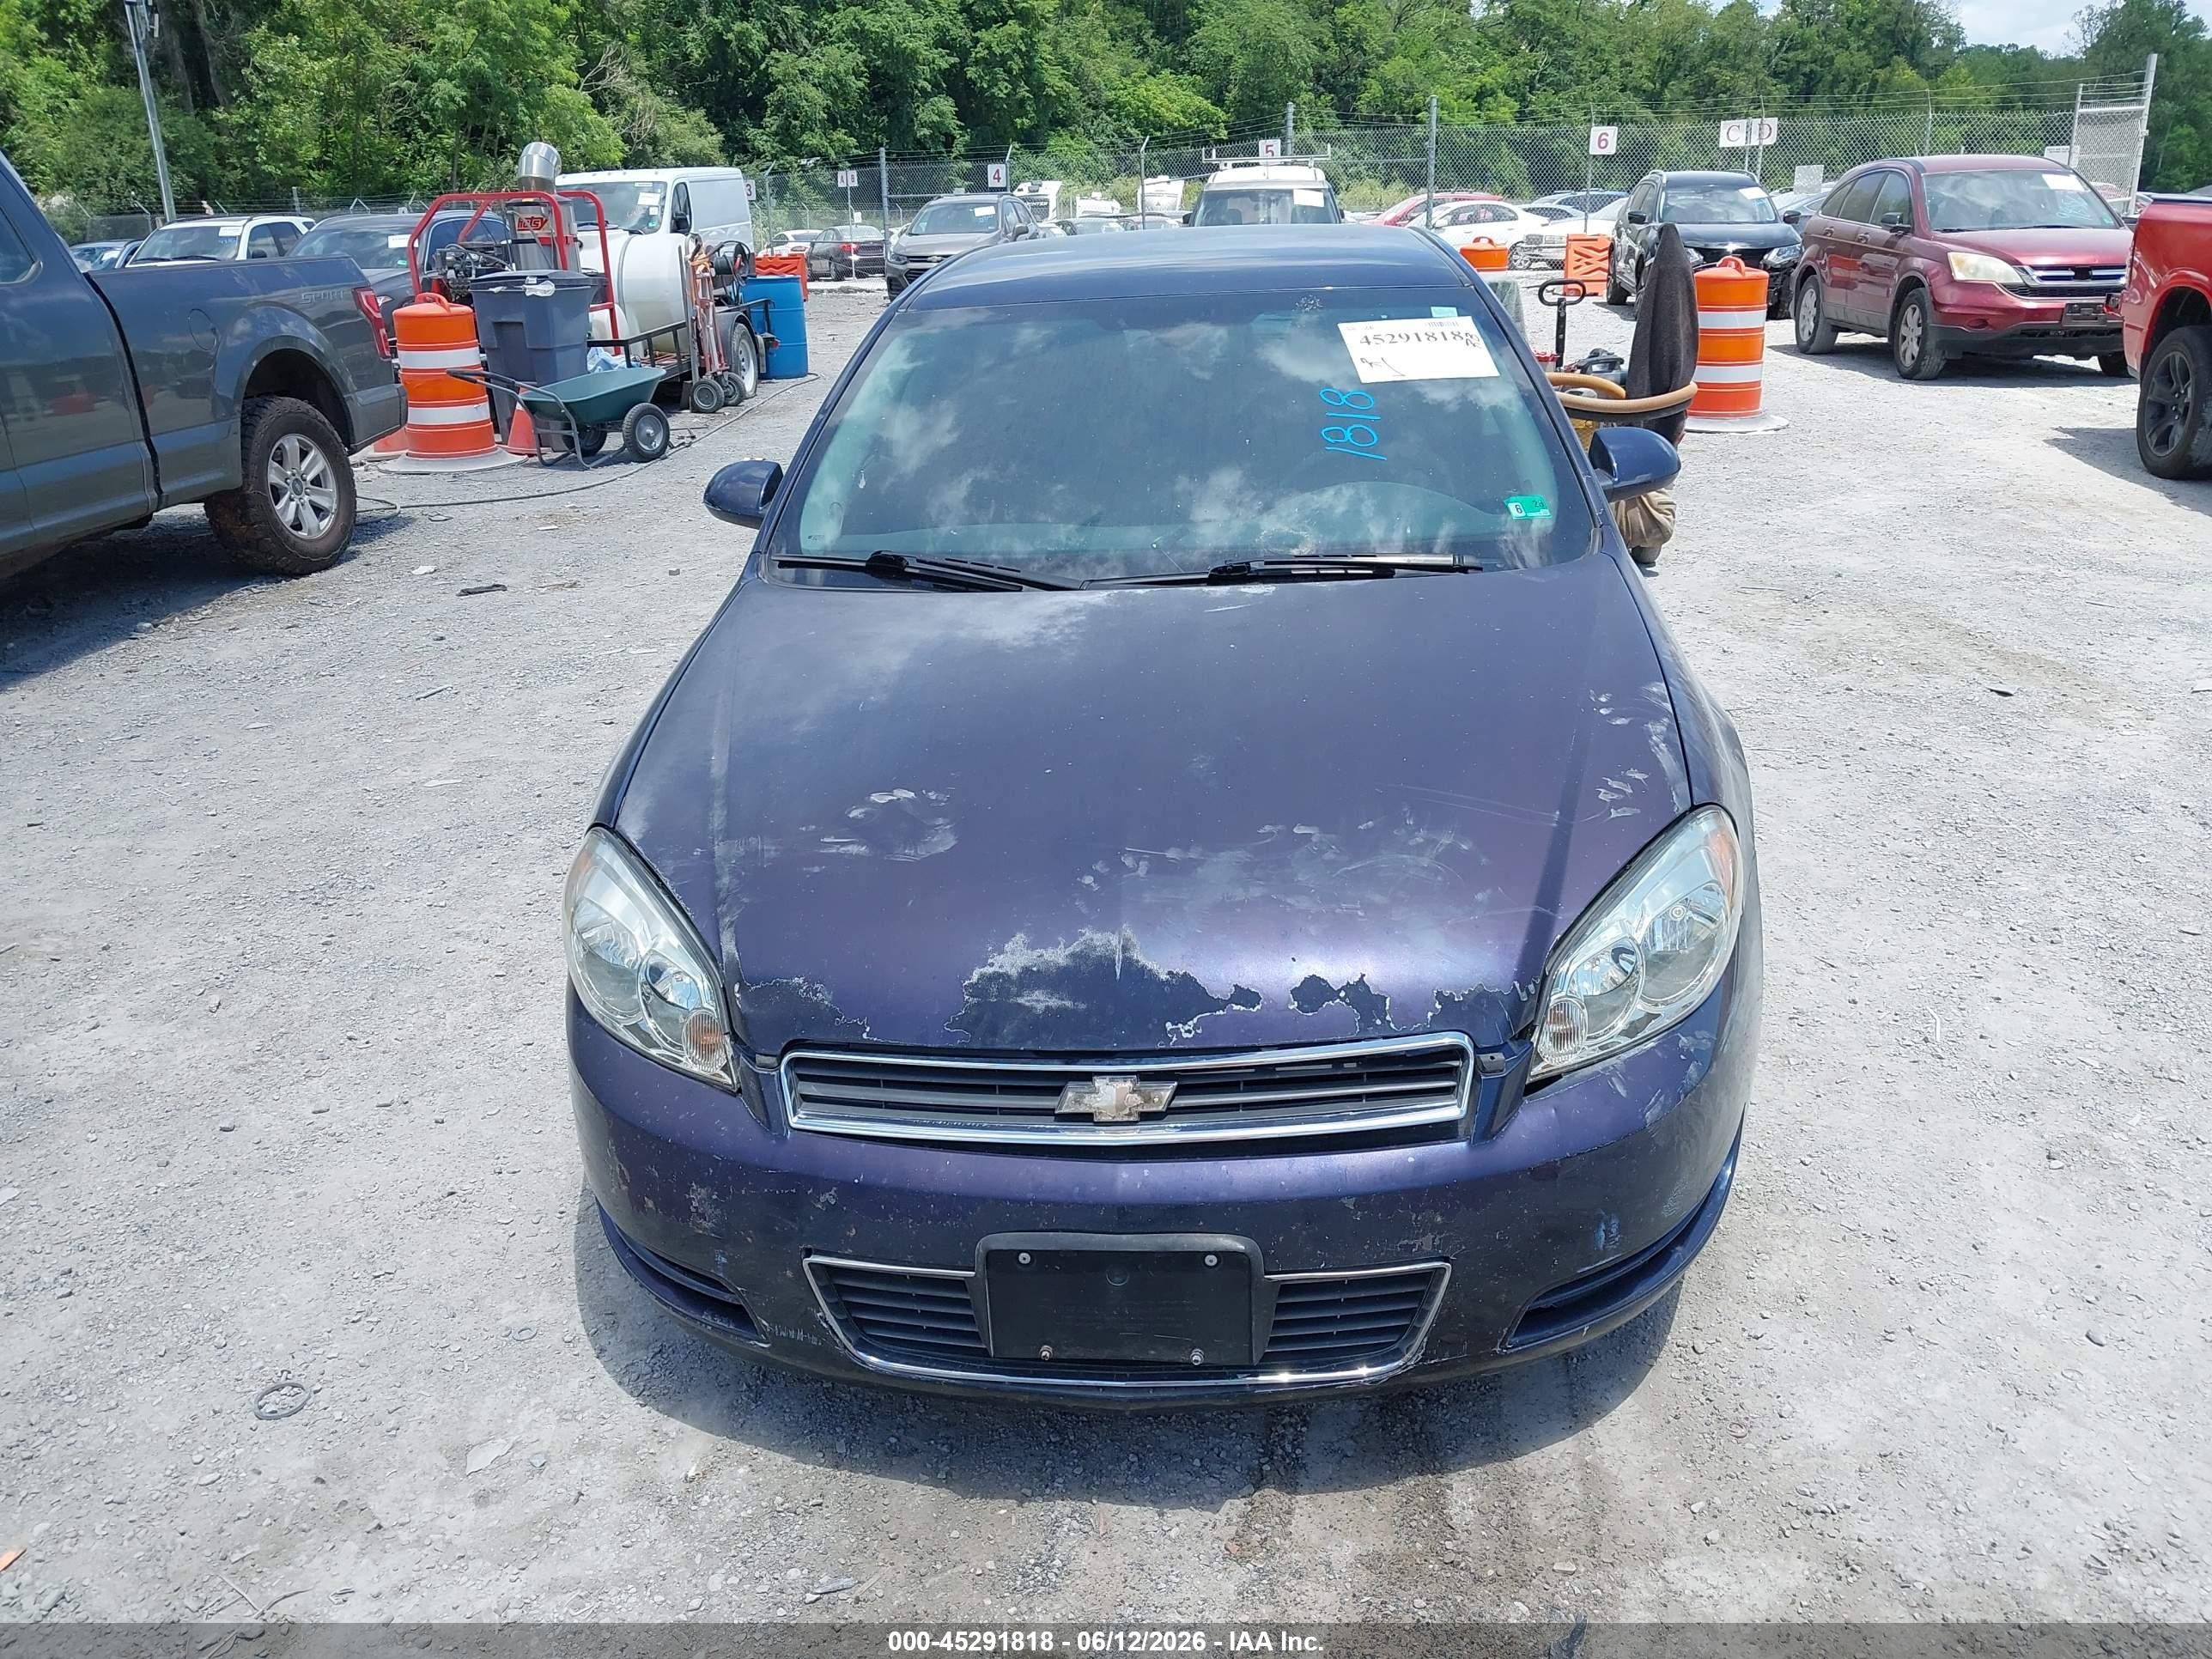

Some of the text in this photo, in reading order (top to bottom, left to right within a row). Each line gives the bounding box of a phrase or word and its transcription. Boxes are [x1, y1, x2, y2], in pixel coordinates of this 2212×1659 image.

[1726, 124, 1741, 143] C
[1758, 123, 1772, 141] D
[1597, 132, 1609, 149] 6
[1265, 144, 1275, 157] 5
[993, 169, 1001, 183] 4
[745, 183, 753, 197] 3
[1359, 331, 1464, 347] 45291818
[1319, 386, 1388, 461] 1818
